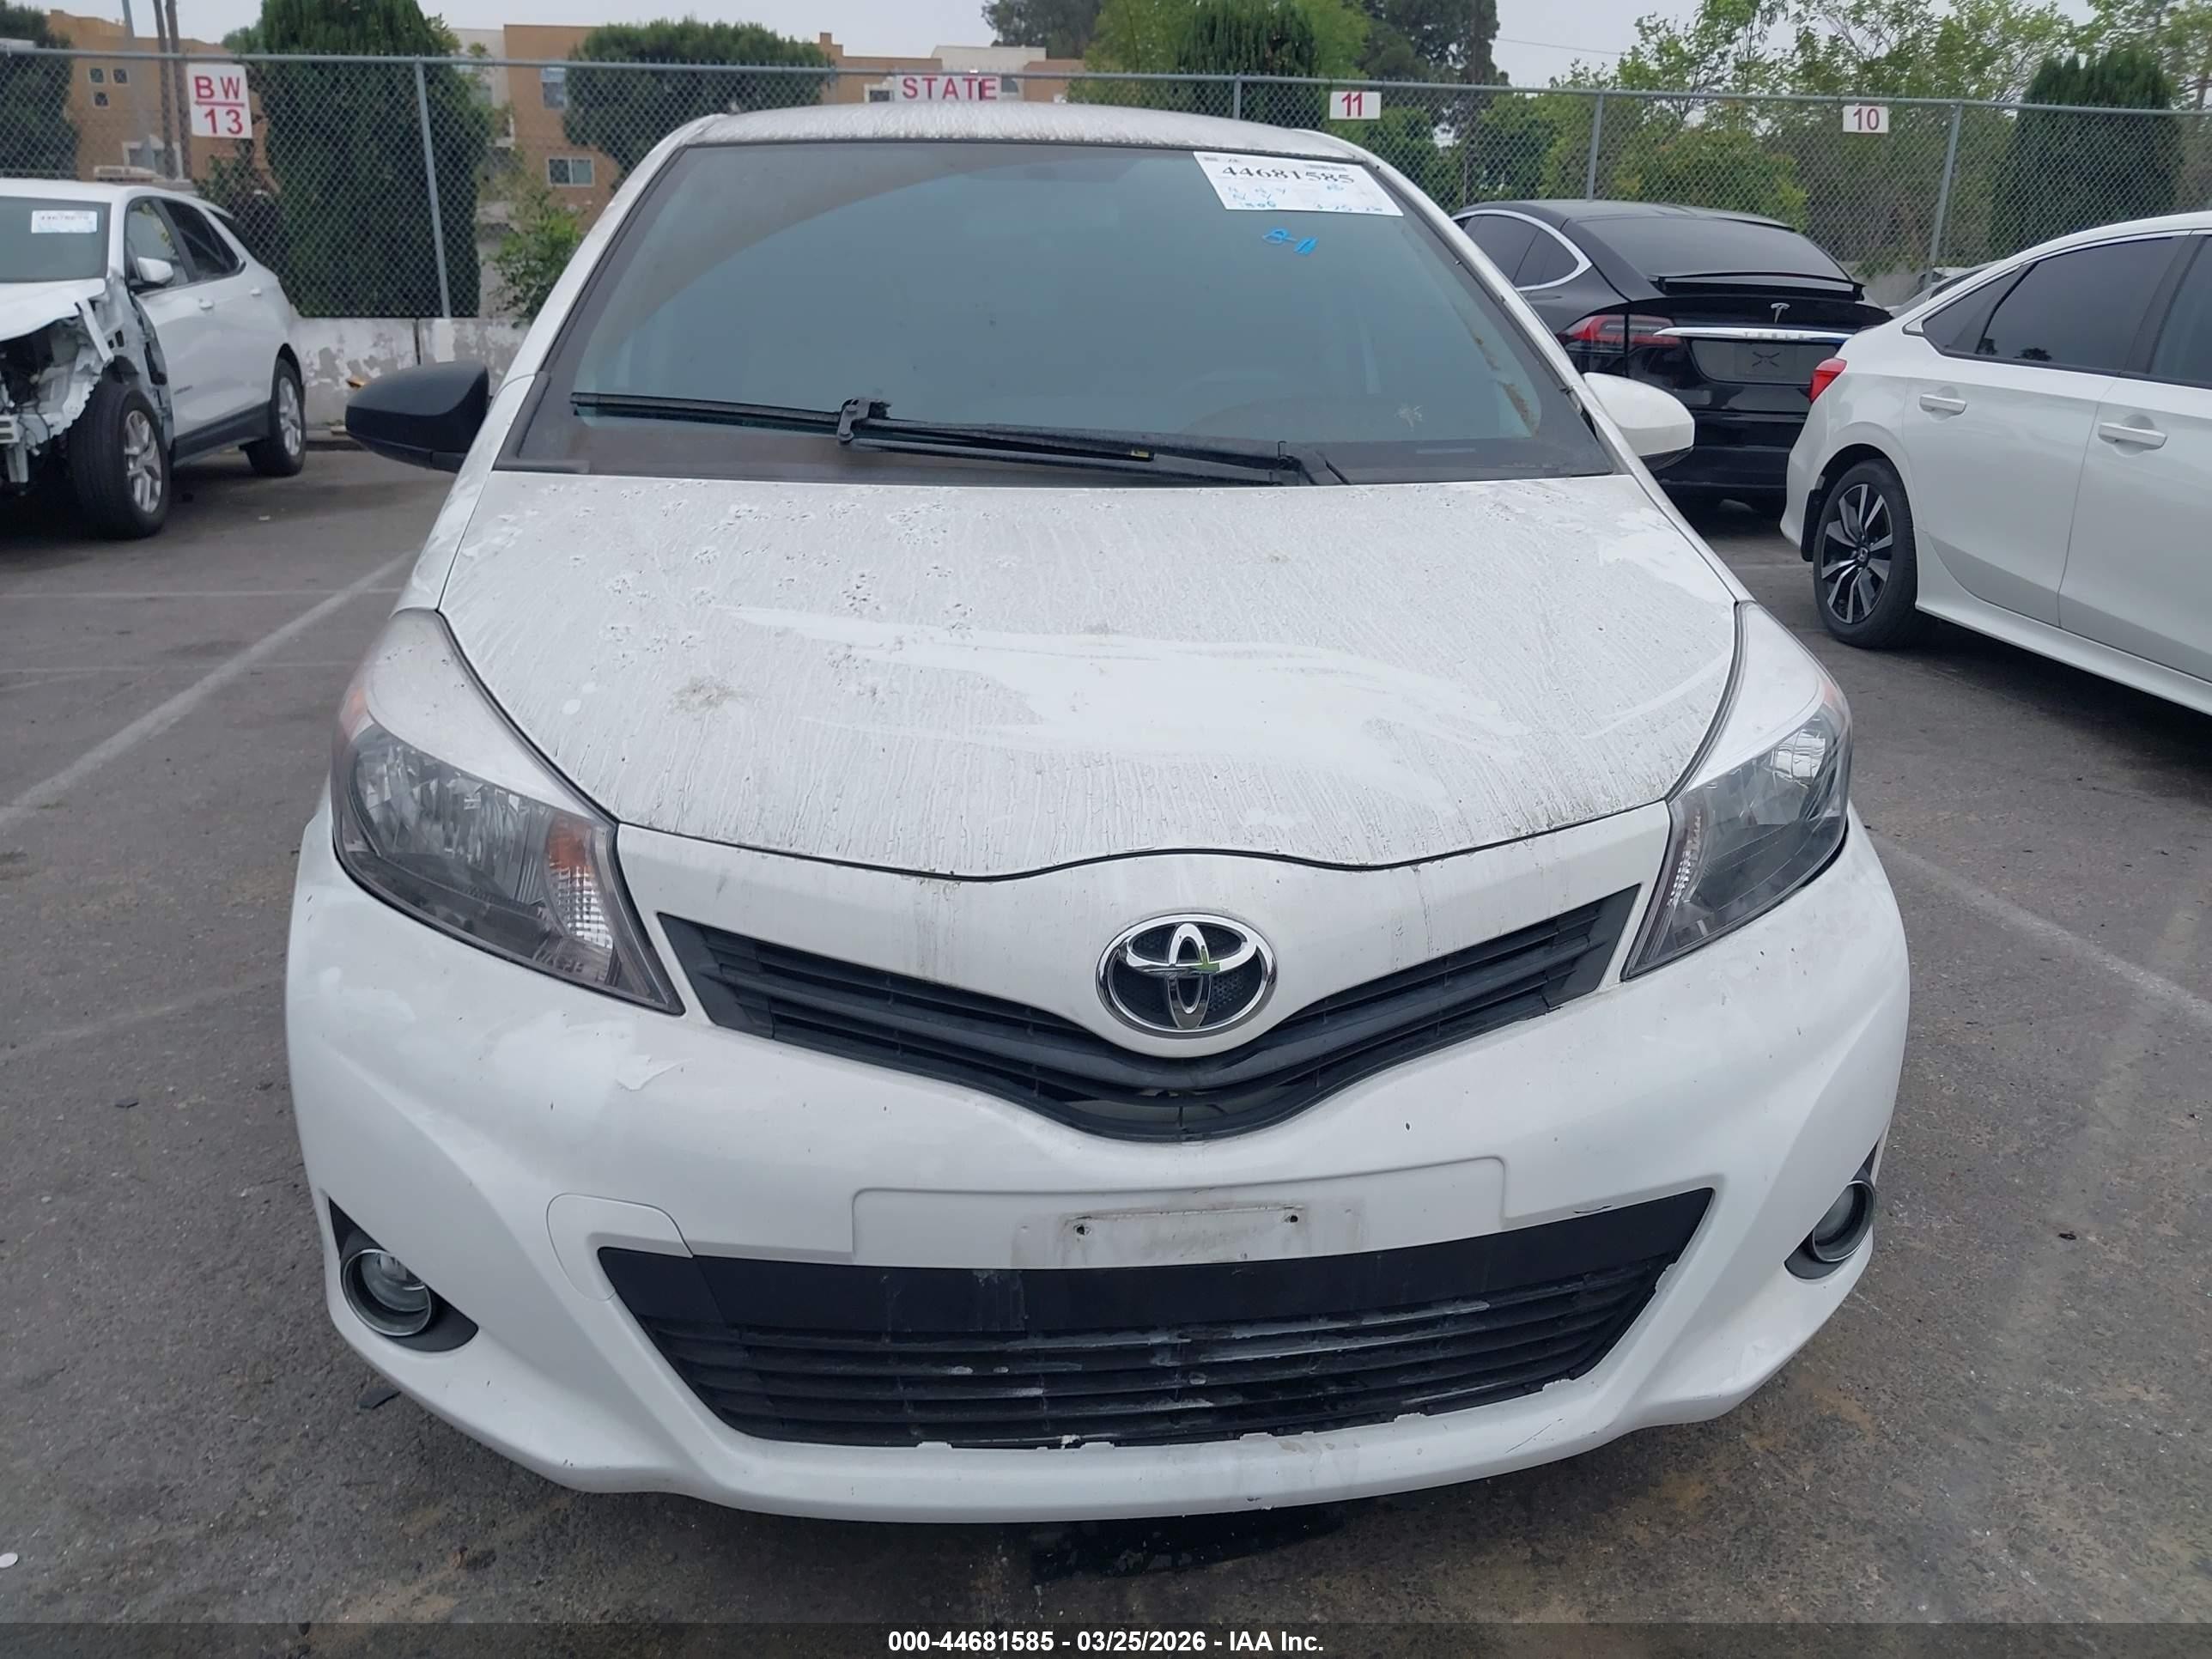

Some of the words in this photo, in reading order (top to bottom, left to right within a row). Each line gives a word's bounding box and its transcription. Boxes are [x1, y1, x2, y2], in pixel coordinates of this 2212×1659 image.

[902, 76, 997, 100] STATE
[1341, 93, 1363, 117] 11
[204, 108, 243, 135] 13
[1853, 107, 1880, 131] 10
[1222, 166, 1354, 184] 44681585
